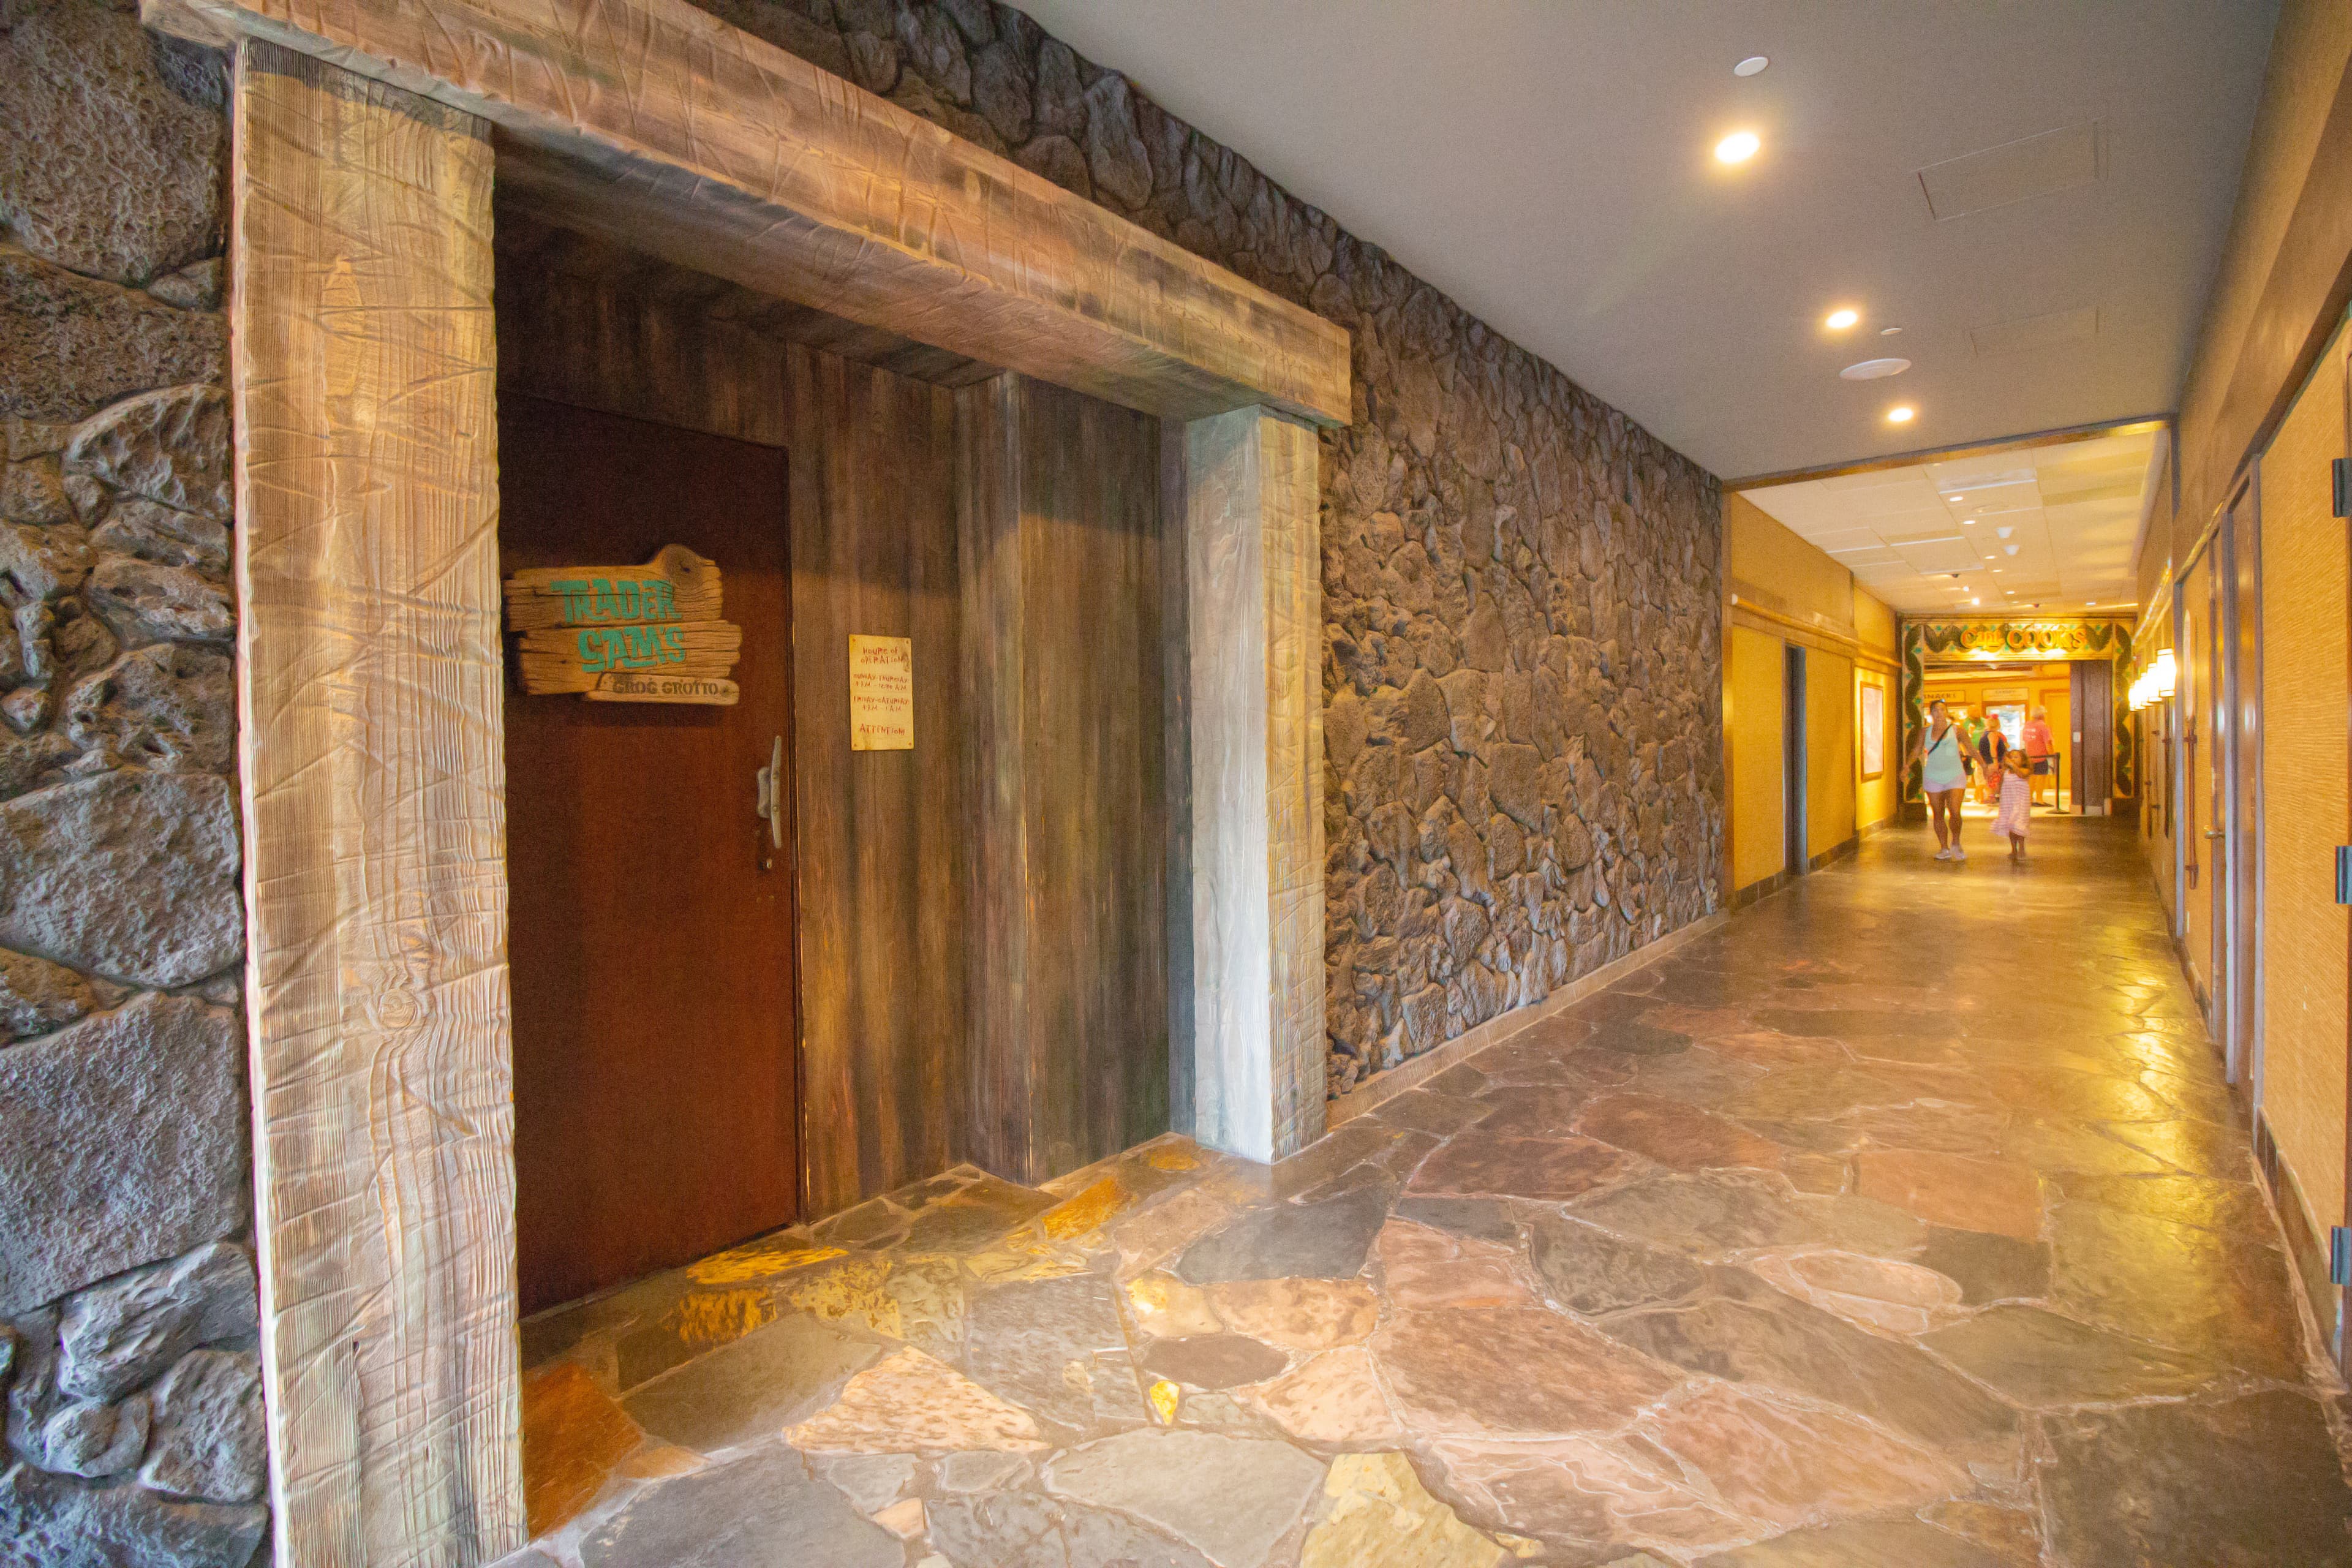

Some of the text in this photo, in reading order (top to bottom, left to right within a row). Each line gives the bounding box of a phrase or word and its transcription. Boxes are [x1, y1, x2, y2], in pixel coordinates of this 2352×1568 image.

[551, 578, 682, 623] TRADER
[578, 626, 686, 673] SAM'S
[612, 681, 718, 695] GROG GROTTO
